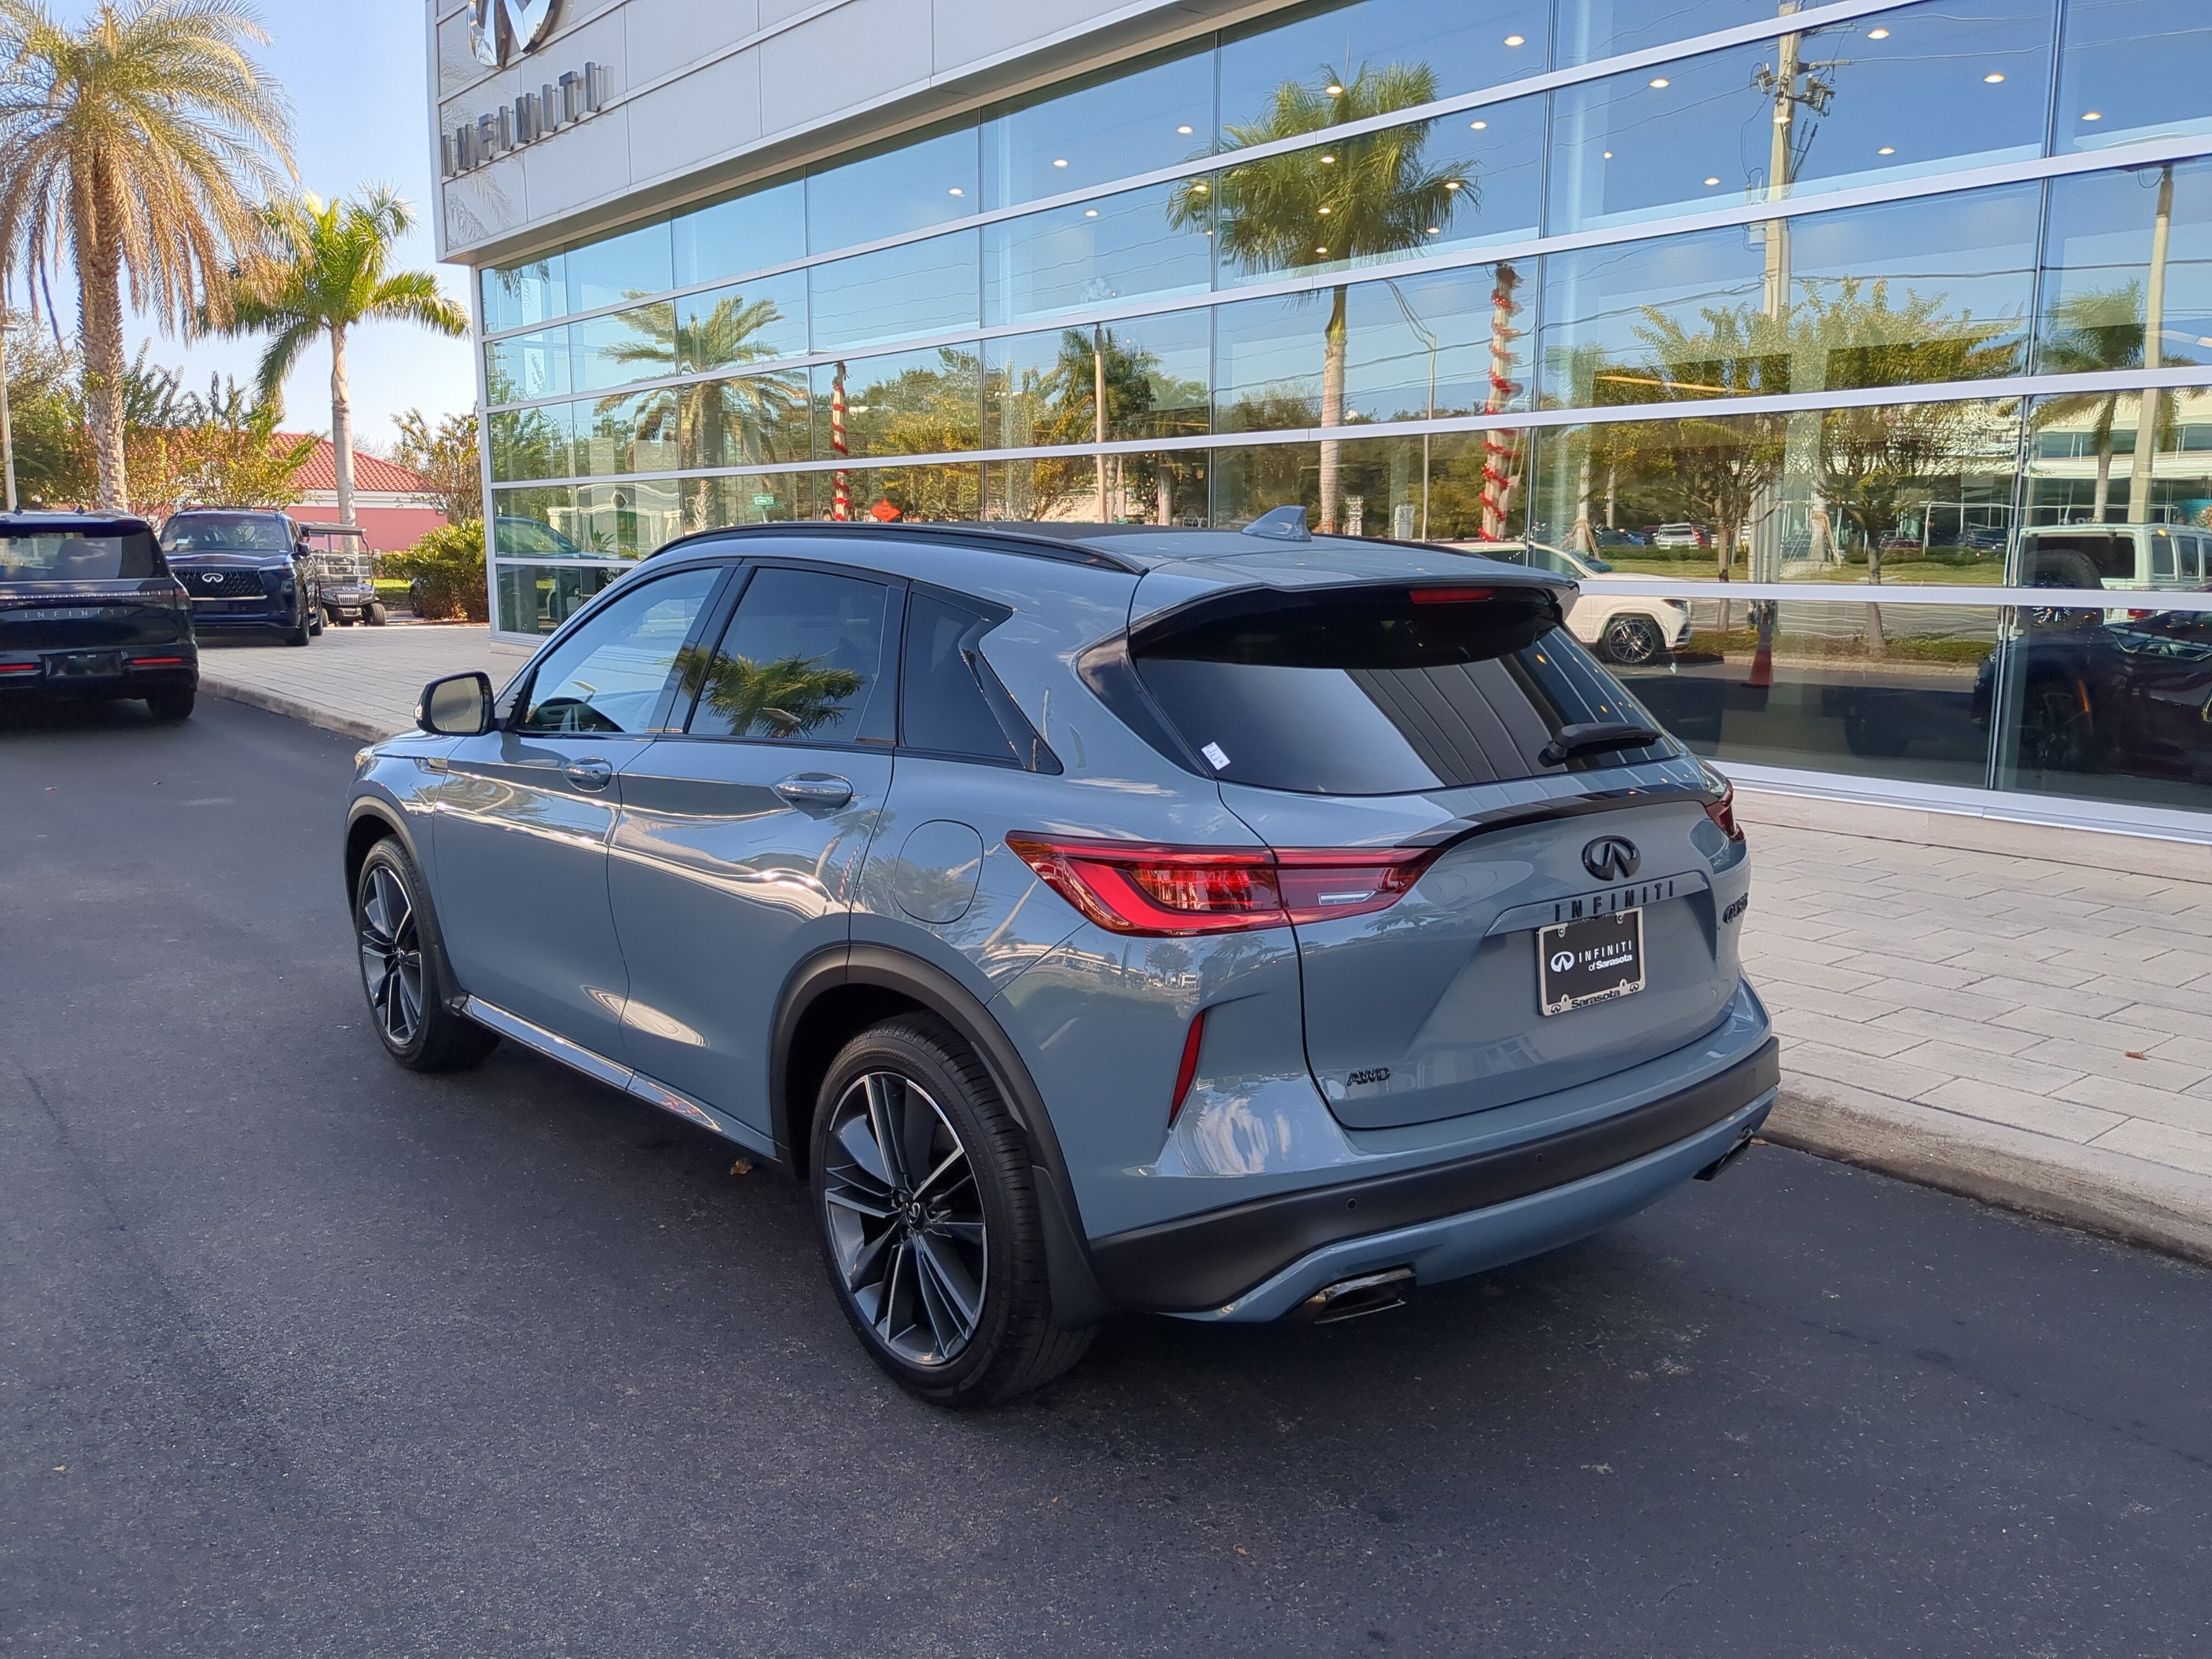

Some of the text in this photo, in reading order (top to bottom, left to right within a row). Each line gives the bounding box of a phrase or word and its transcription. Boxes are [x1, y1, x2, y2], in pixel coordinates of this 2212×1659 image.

[442, 61, 599, 177] INFINITI
[24, 608, 128, 619] INFINITI
[1555, 881, 1673, 922] INFINITI
[1578, 940, 1632, 963] INFINITI
[1588, 953, 1633, 972] of Sarasota
[1571, 990, 1621, 1008] Sarasota
[1347, 1068, 1391, 1086] AWD
